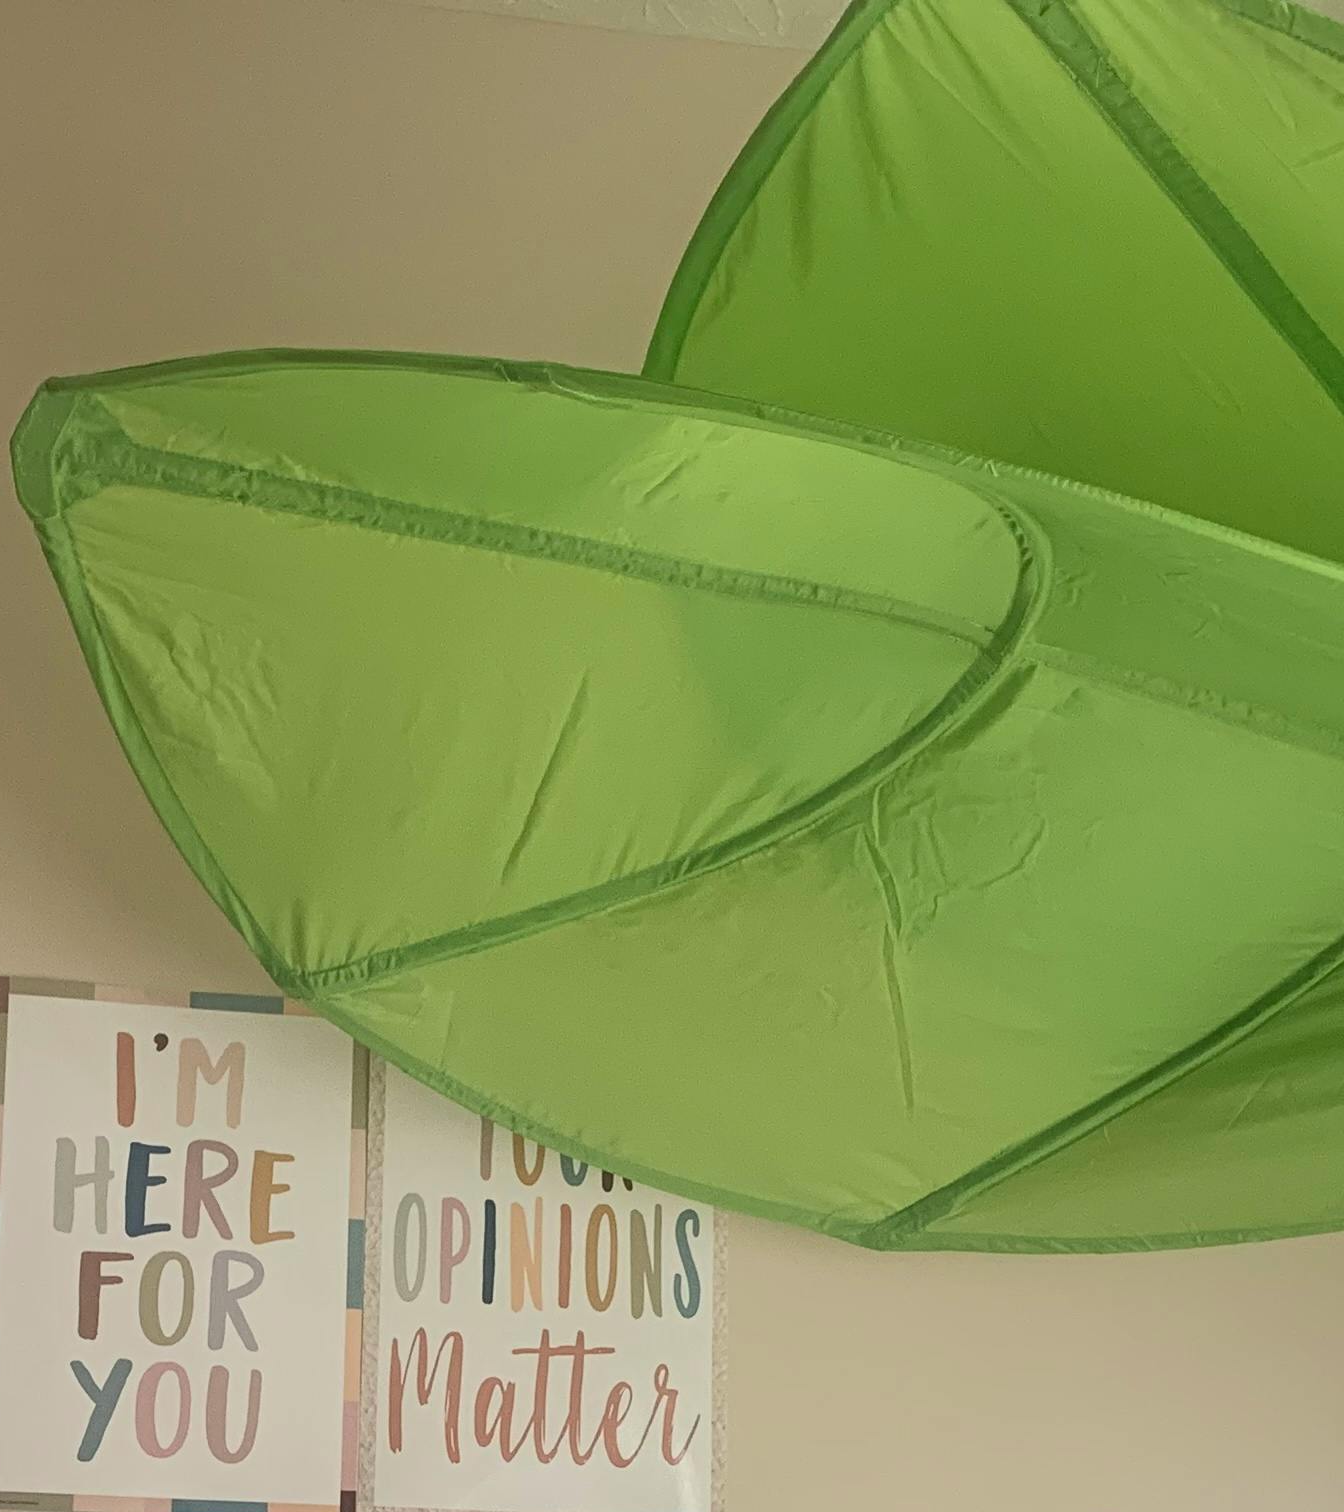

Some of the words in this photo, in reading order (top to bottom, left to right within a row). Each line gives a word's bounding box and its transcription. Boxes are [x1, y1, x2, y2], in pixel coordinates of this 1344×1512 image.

[116, 1031, 246, 1129] I'M
[52, 1136, 296, 1246] HERE
[78, 1250, 266, 1353] FOR
[393, 1192, 701, 1320] OPINIONS
[69, 1359, 263, 1464] YOU
[388, 1326, 701, 1469] Matter
